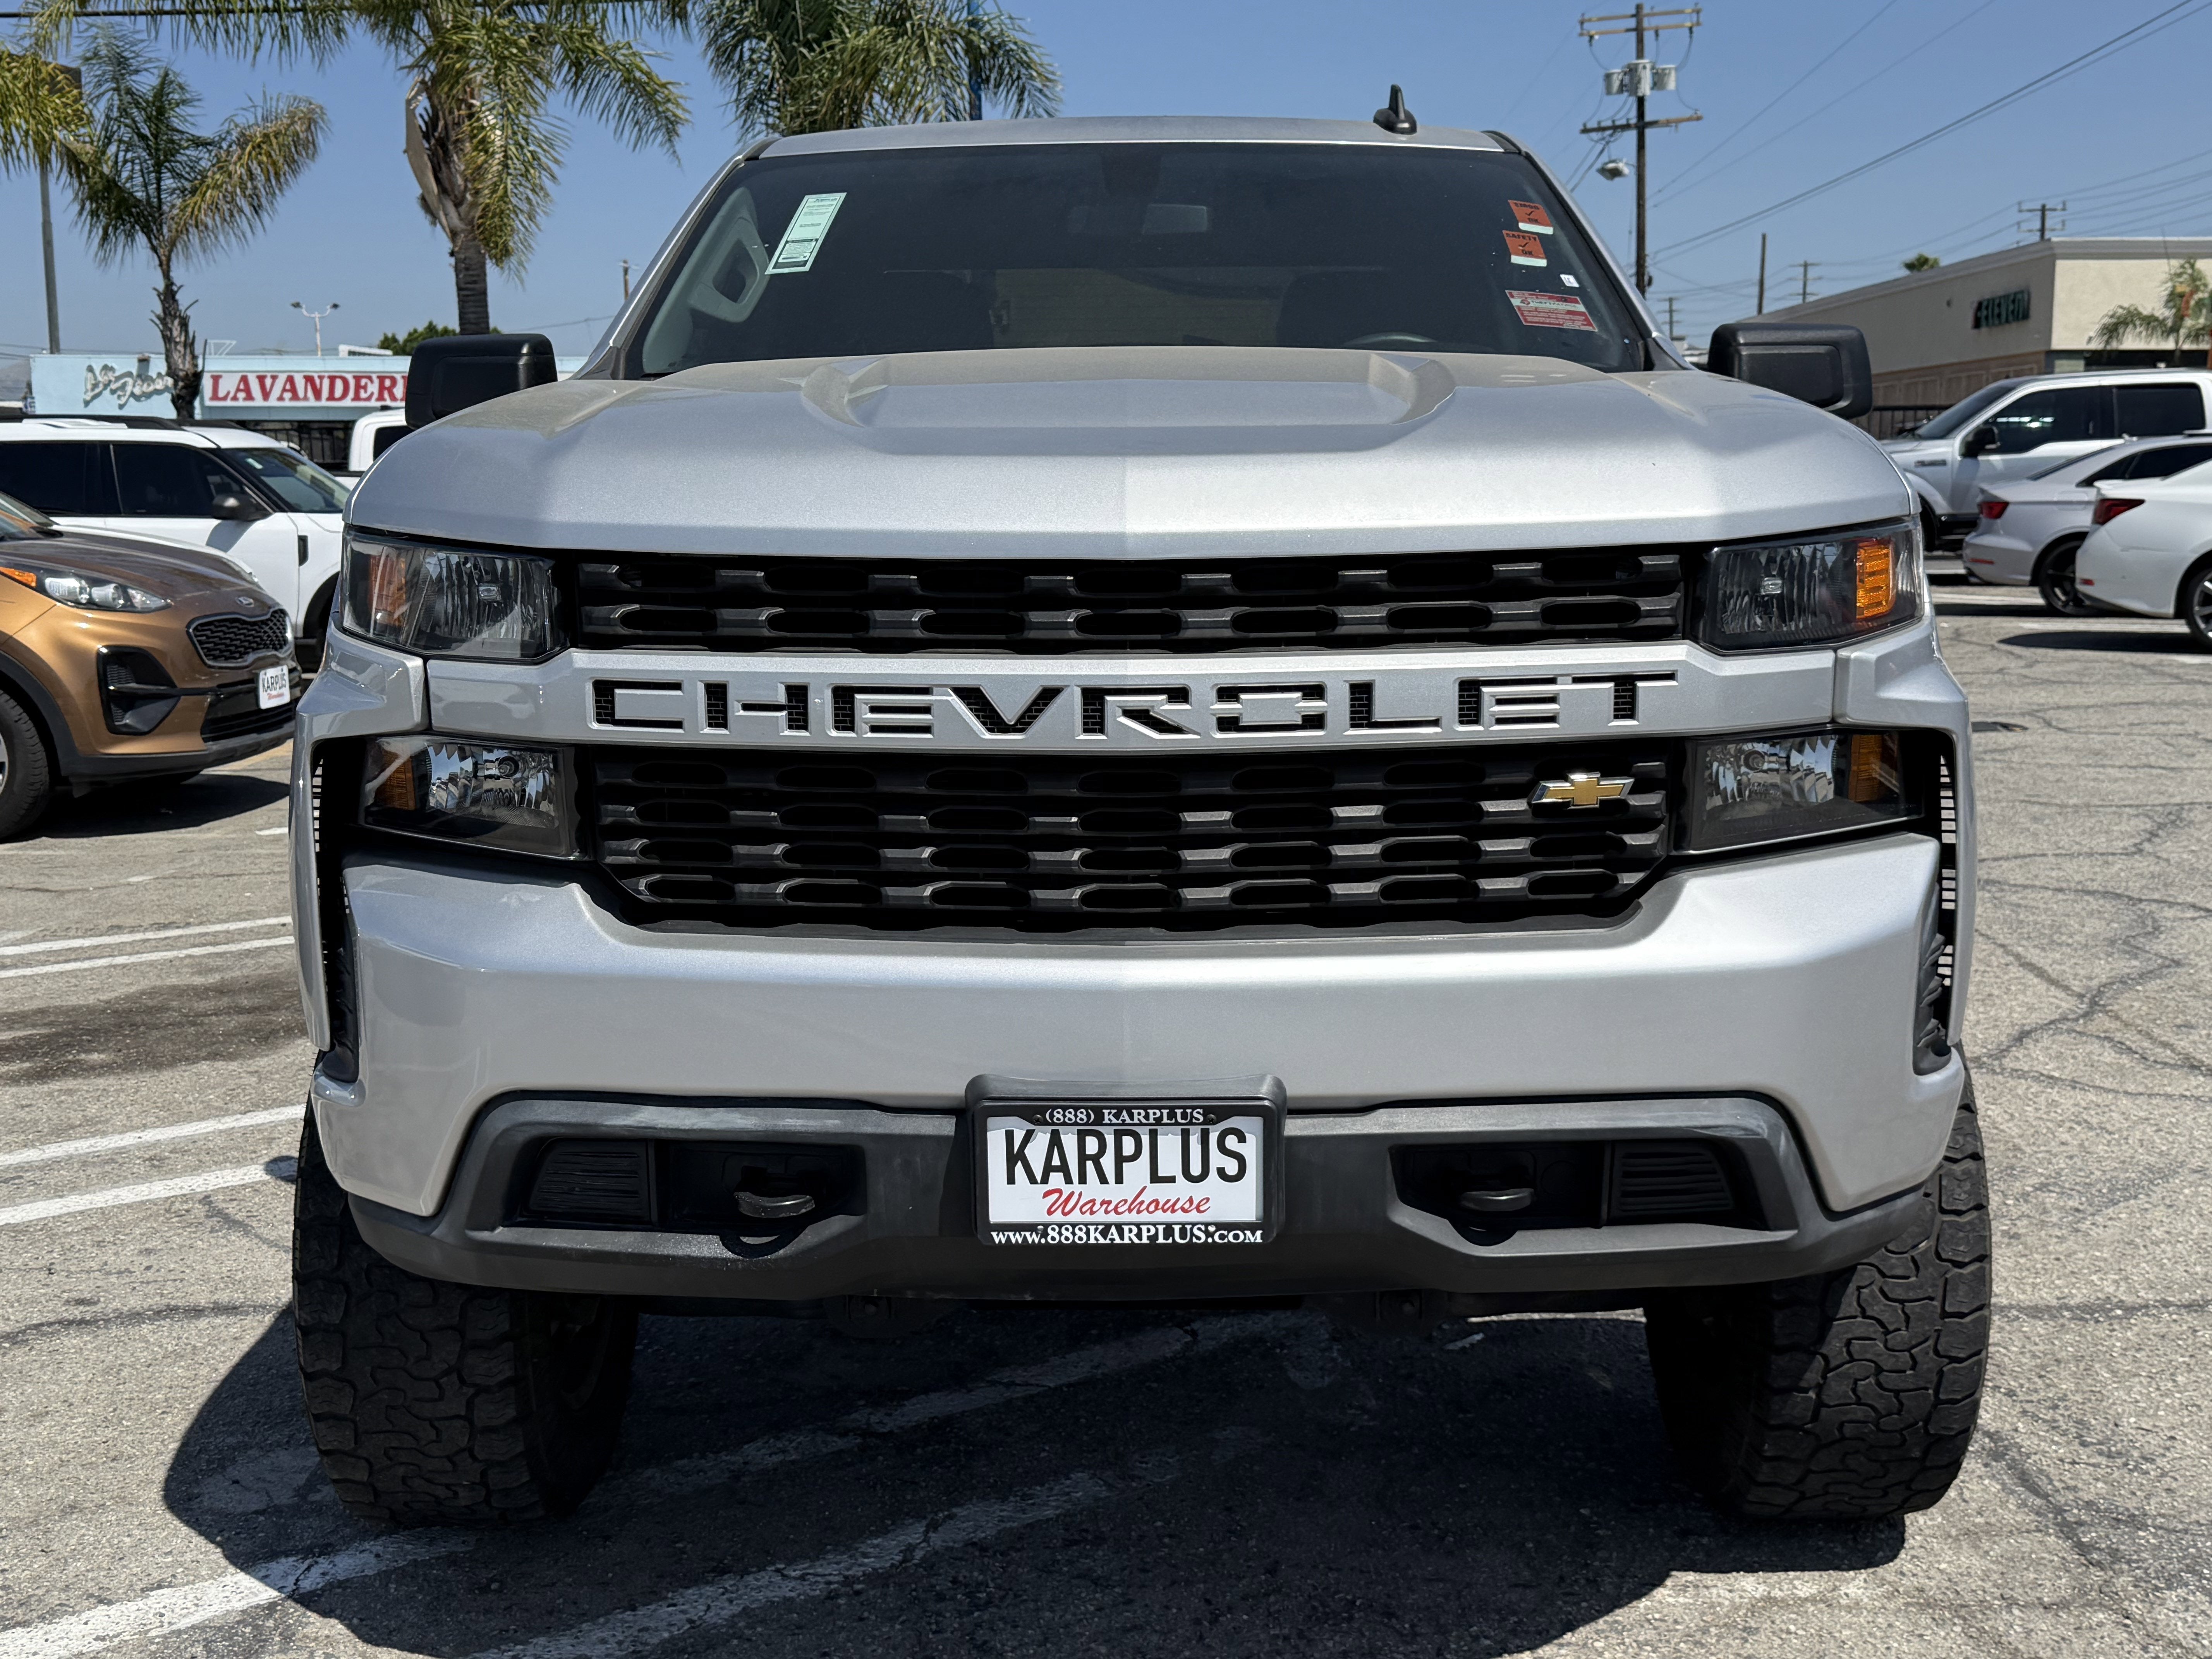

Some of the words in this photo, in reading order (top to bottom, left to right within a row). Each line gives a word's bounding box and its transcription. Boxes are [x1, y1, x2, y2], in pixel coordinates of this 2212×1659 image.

[1505, 233, 1537, 241] SAFETY
[589, 671, 1678, 738] CHEVROLET
[1046, 1108, 1094, 1123] (888)
[1102, 1109, 1204, 1123] KARPLUS
[1005, 1127, 1247, 1185] KARPLUS
[1042, 1185, 1211, 1217] Warehouse
